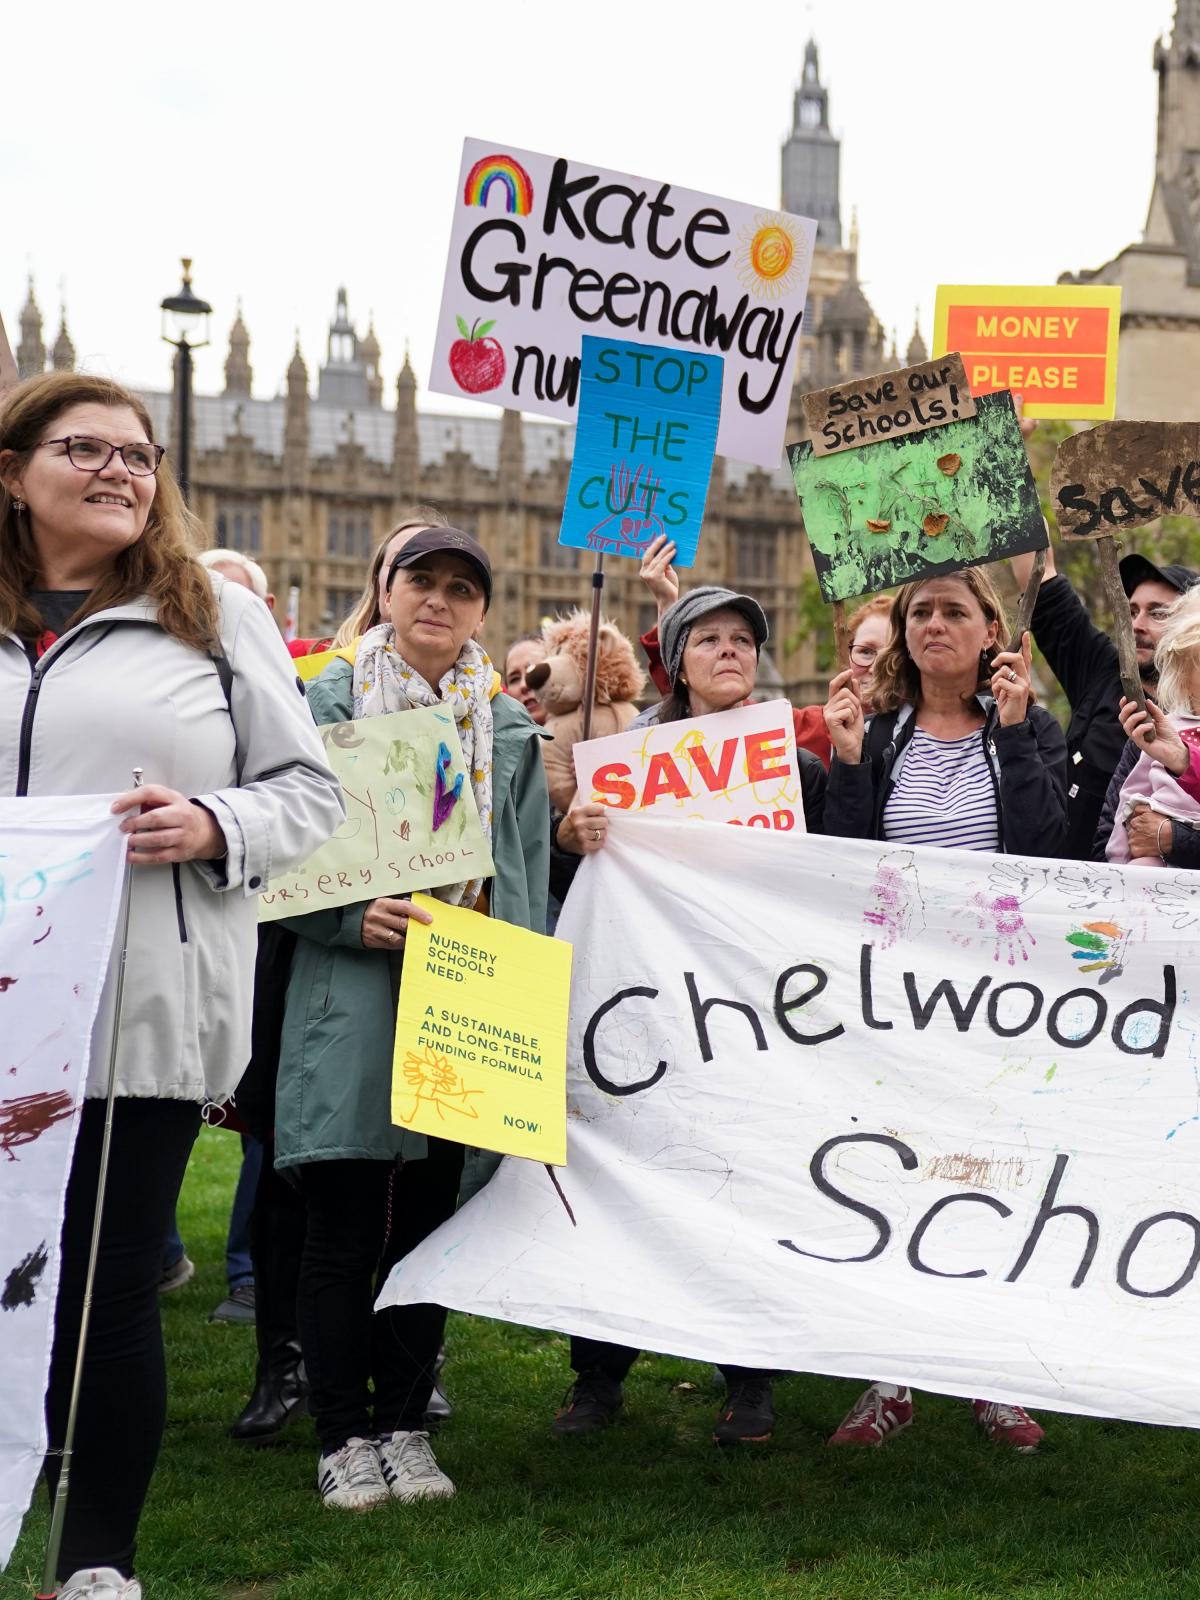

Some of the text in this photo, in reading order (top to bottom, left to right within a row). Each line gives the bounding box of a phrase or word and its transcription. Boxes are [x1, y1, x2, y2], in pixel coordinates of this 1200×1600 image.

[460, 219, 803, 414] Greenaway
[976, 316, 1080, 339] MONEY
[594, 350, 709, 396] STOP
[972, 365, 1079, 389] PLEASE
[821, 383, 961, 450] Schools!
[827, 381, 898, 418] Save
[605, 412, 689, 460] THE
[578, 476, 689, 525] CUTS
[591, 727, 791, 810] SAVE
[428, 947, 495, 977] SCHOOLS
[430, 933, 497, 965] NURSERY
[426, 962, 467, 985] NEED:
[421, 1021, 452, 1038] AND
[425, 1006, 434, 1017] A
[582, 944, 1176, 1097] Chelwood
[418, 1037, 543, 1081] FUNDING FORMULA
[503, 1115, 542, 1134] NOW!
